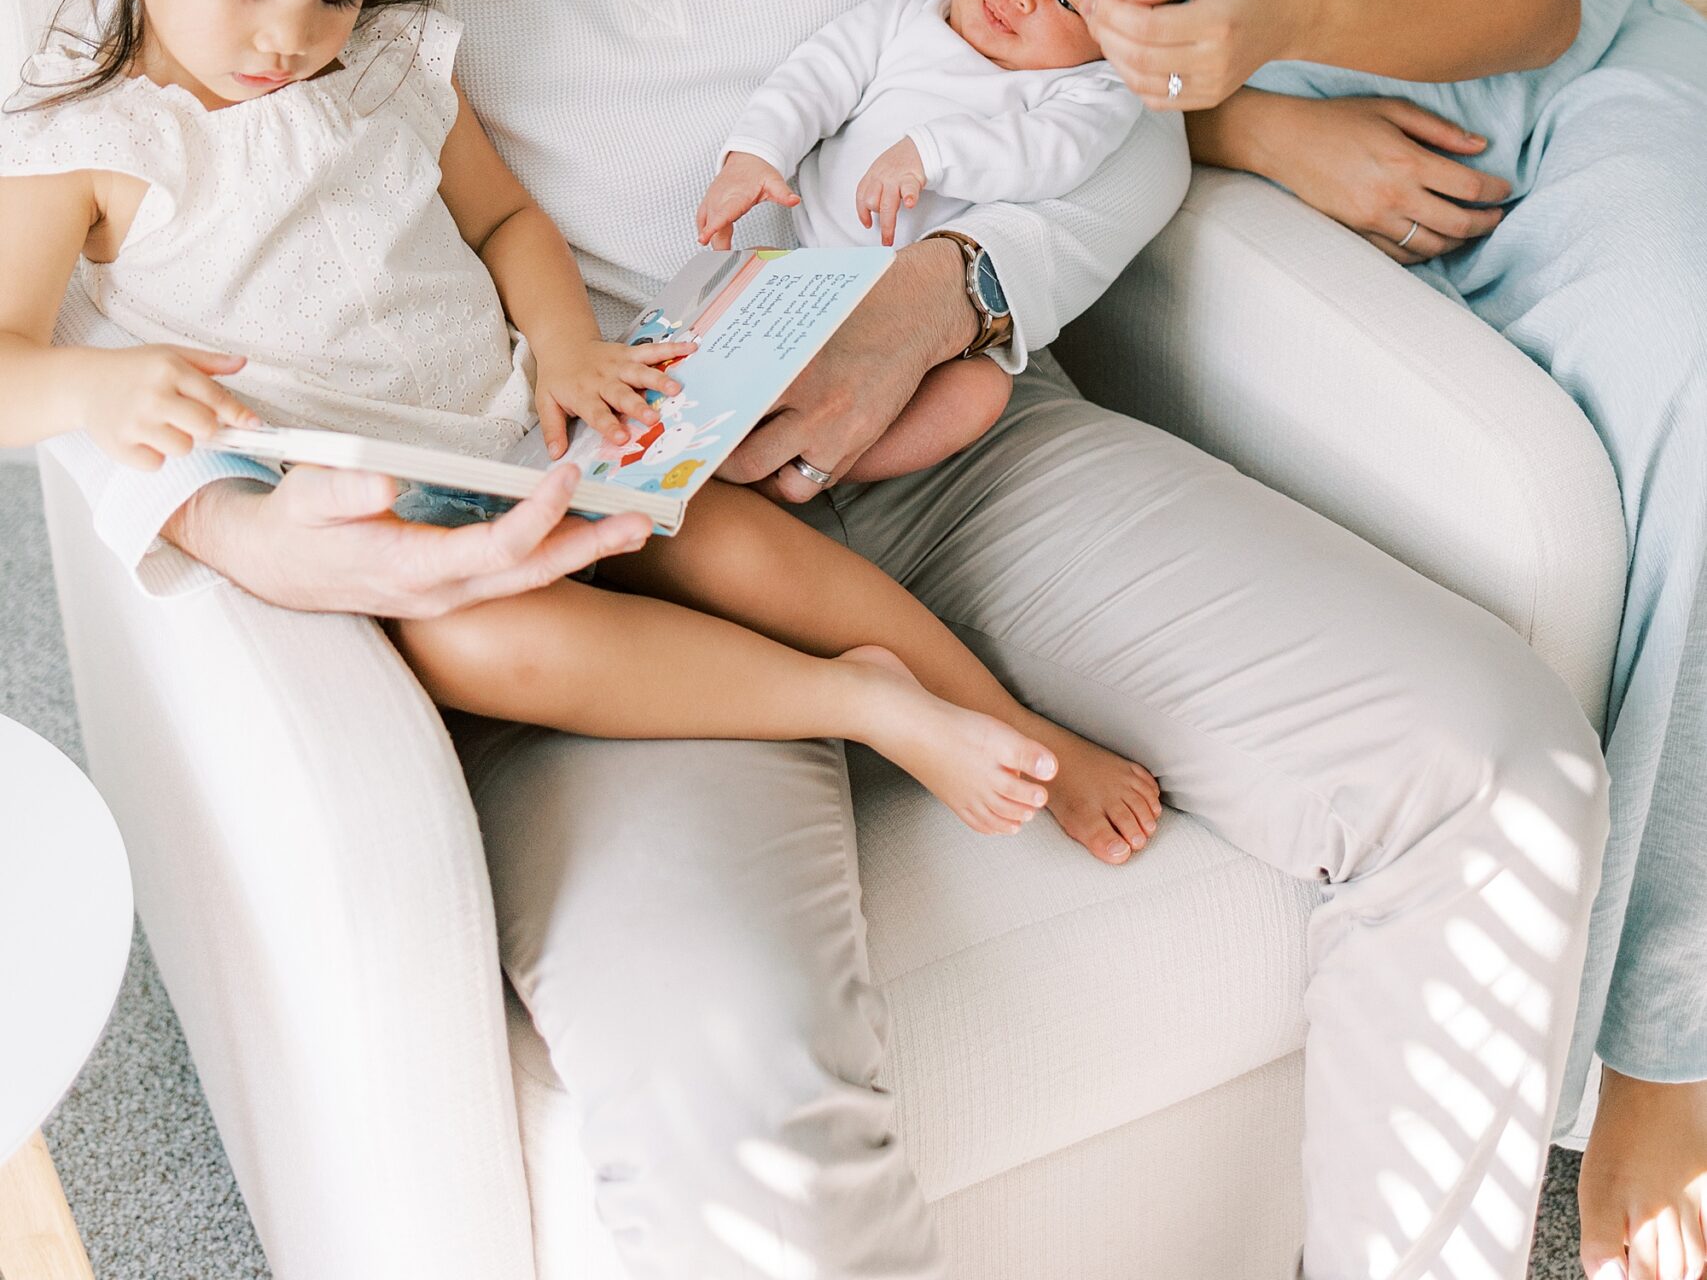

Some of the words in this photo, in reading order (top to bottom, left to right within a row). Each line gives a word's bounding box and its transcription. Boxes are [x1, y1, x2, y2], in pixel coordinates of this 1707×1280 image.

[765, 274, 780, 286] All
[775, 274, 791, 287] Go
[784, 274, 804, 290] The
[797, 274, 823, 298] Round
[809, 273, 835, 298] Round
[830, 273, 846, 286] Go
[840, 273, 860, 289] The
[739, 287, 767, 316] through
[755, 288, 776, 310] round
[761, 292, 784, 317] wheels
[810, 288, 831, 309] round
[816, 291, 840, 317] wheels
[783, 300, 797, 315] and
[794, 299, 809, 315] and
[726, 318, 740, 331] the
[741, 311, 756, 326] and
[751, 319, 761, 329] on
[796, 311, 811, 327] and
[806, 319, 816, 329] on
[737, 330, 752, 343] the
[793, 331, 807, 344] the
[724, 345, 742, 359] bus
[779, 346, 796, 361] bus
